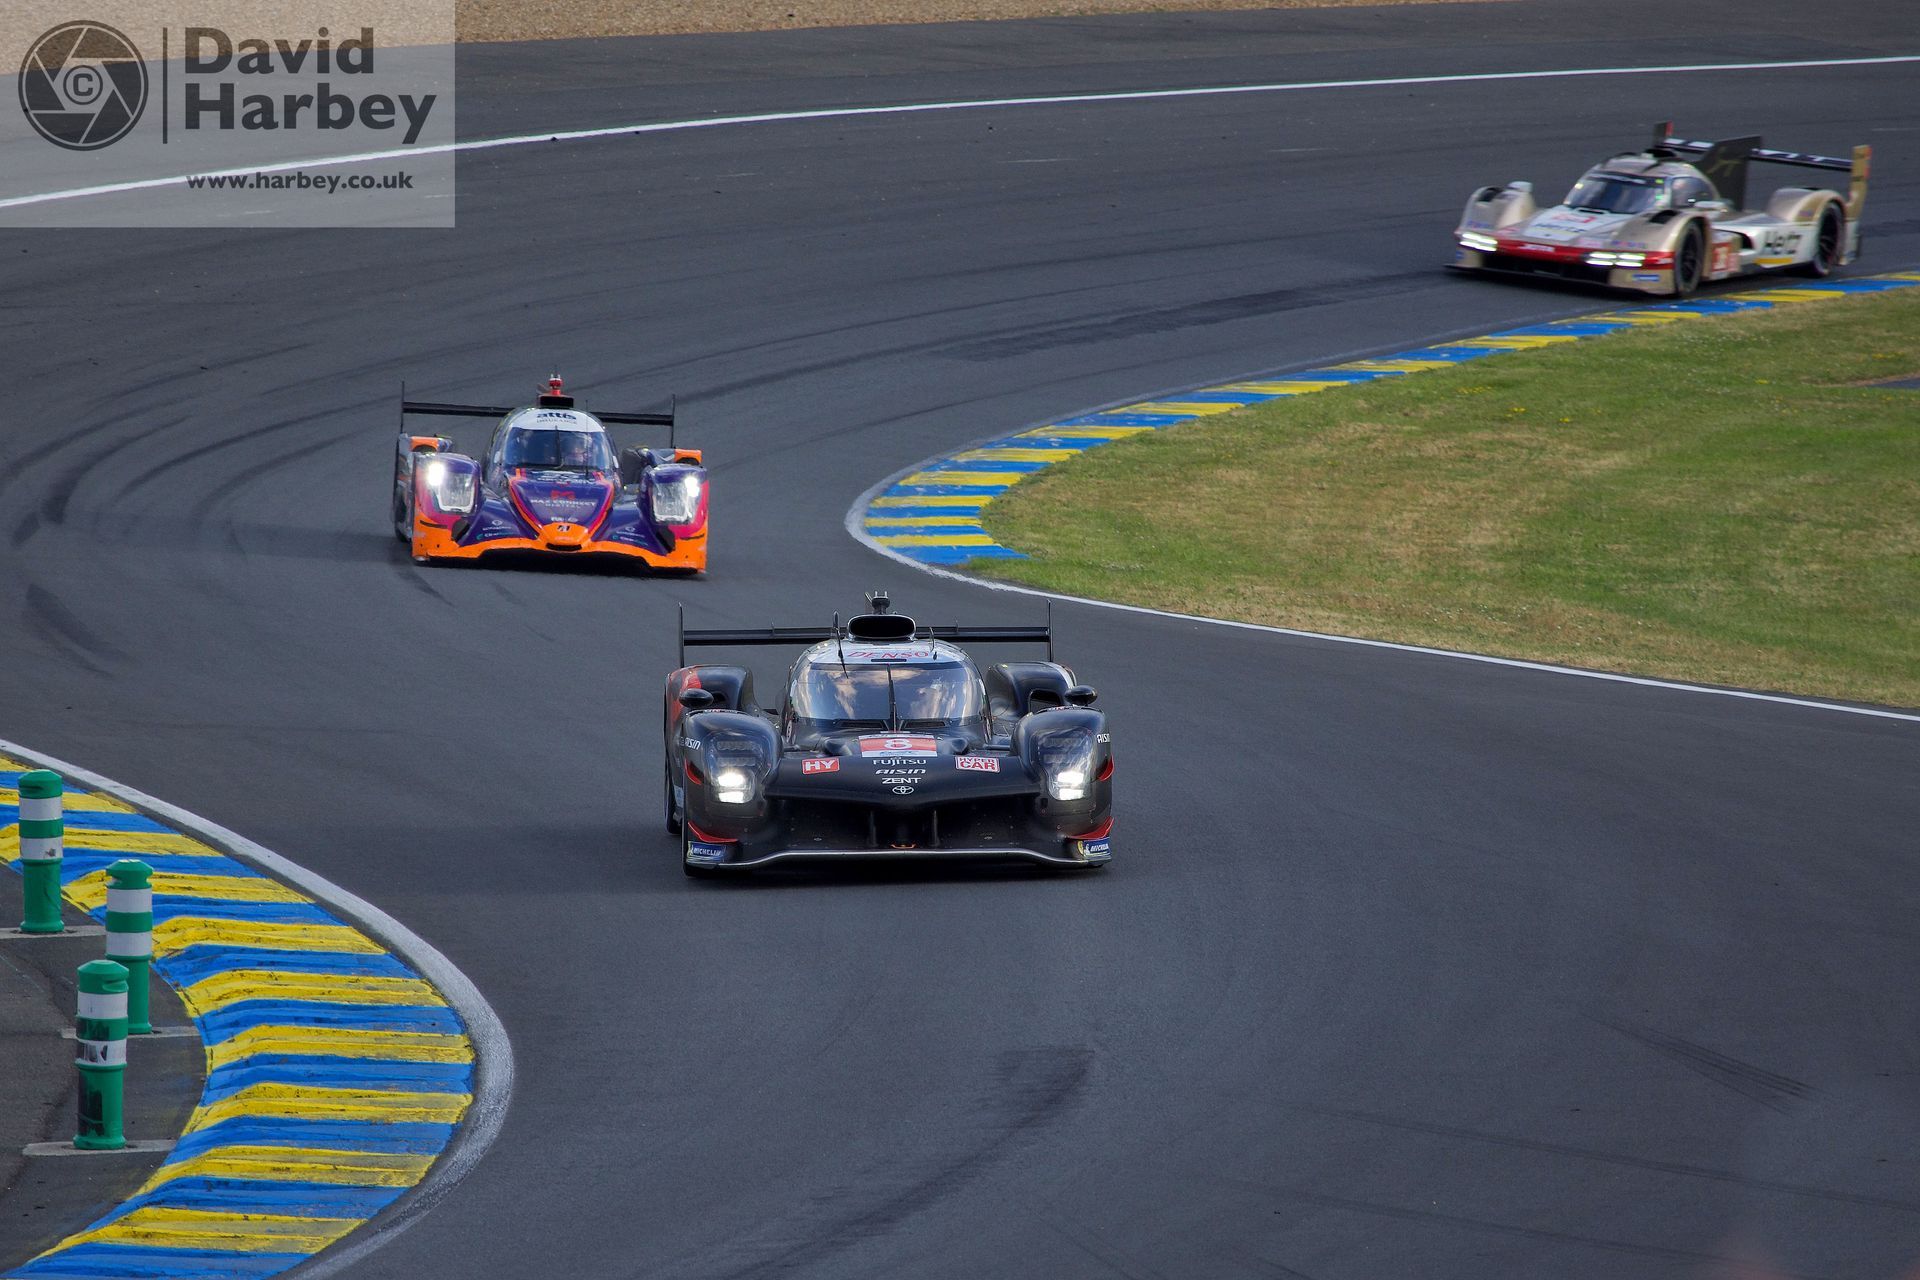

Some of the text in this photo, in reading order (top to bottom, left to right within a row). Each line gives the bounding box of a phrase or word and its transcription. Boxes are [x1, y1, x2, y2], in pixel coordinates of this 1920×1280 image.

[847, 651, 929, 659] DENSO
[884, 738, 913, 750] 8
[805, 759, 835, 771] HY
[960, 761, 996, 770] CAR
[881, 777, 922, 785] ZENT
